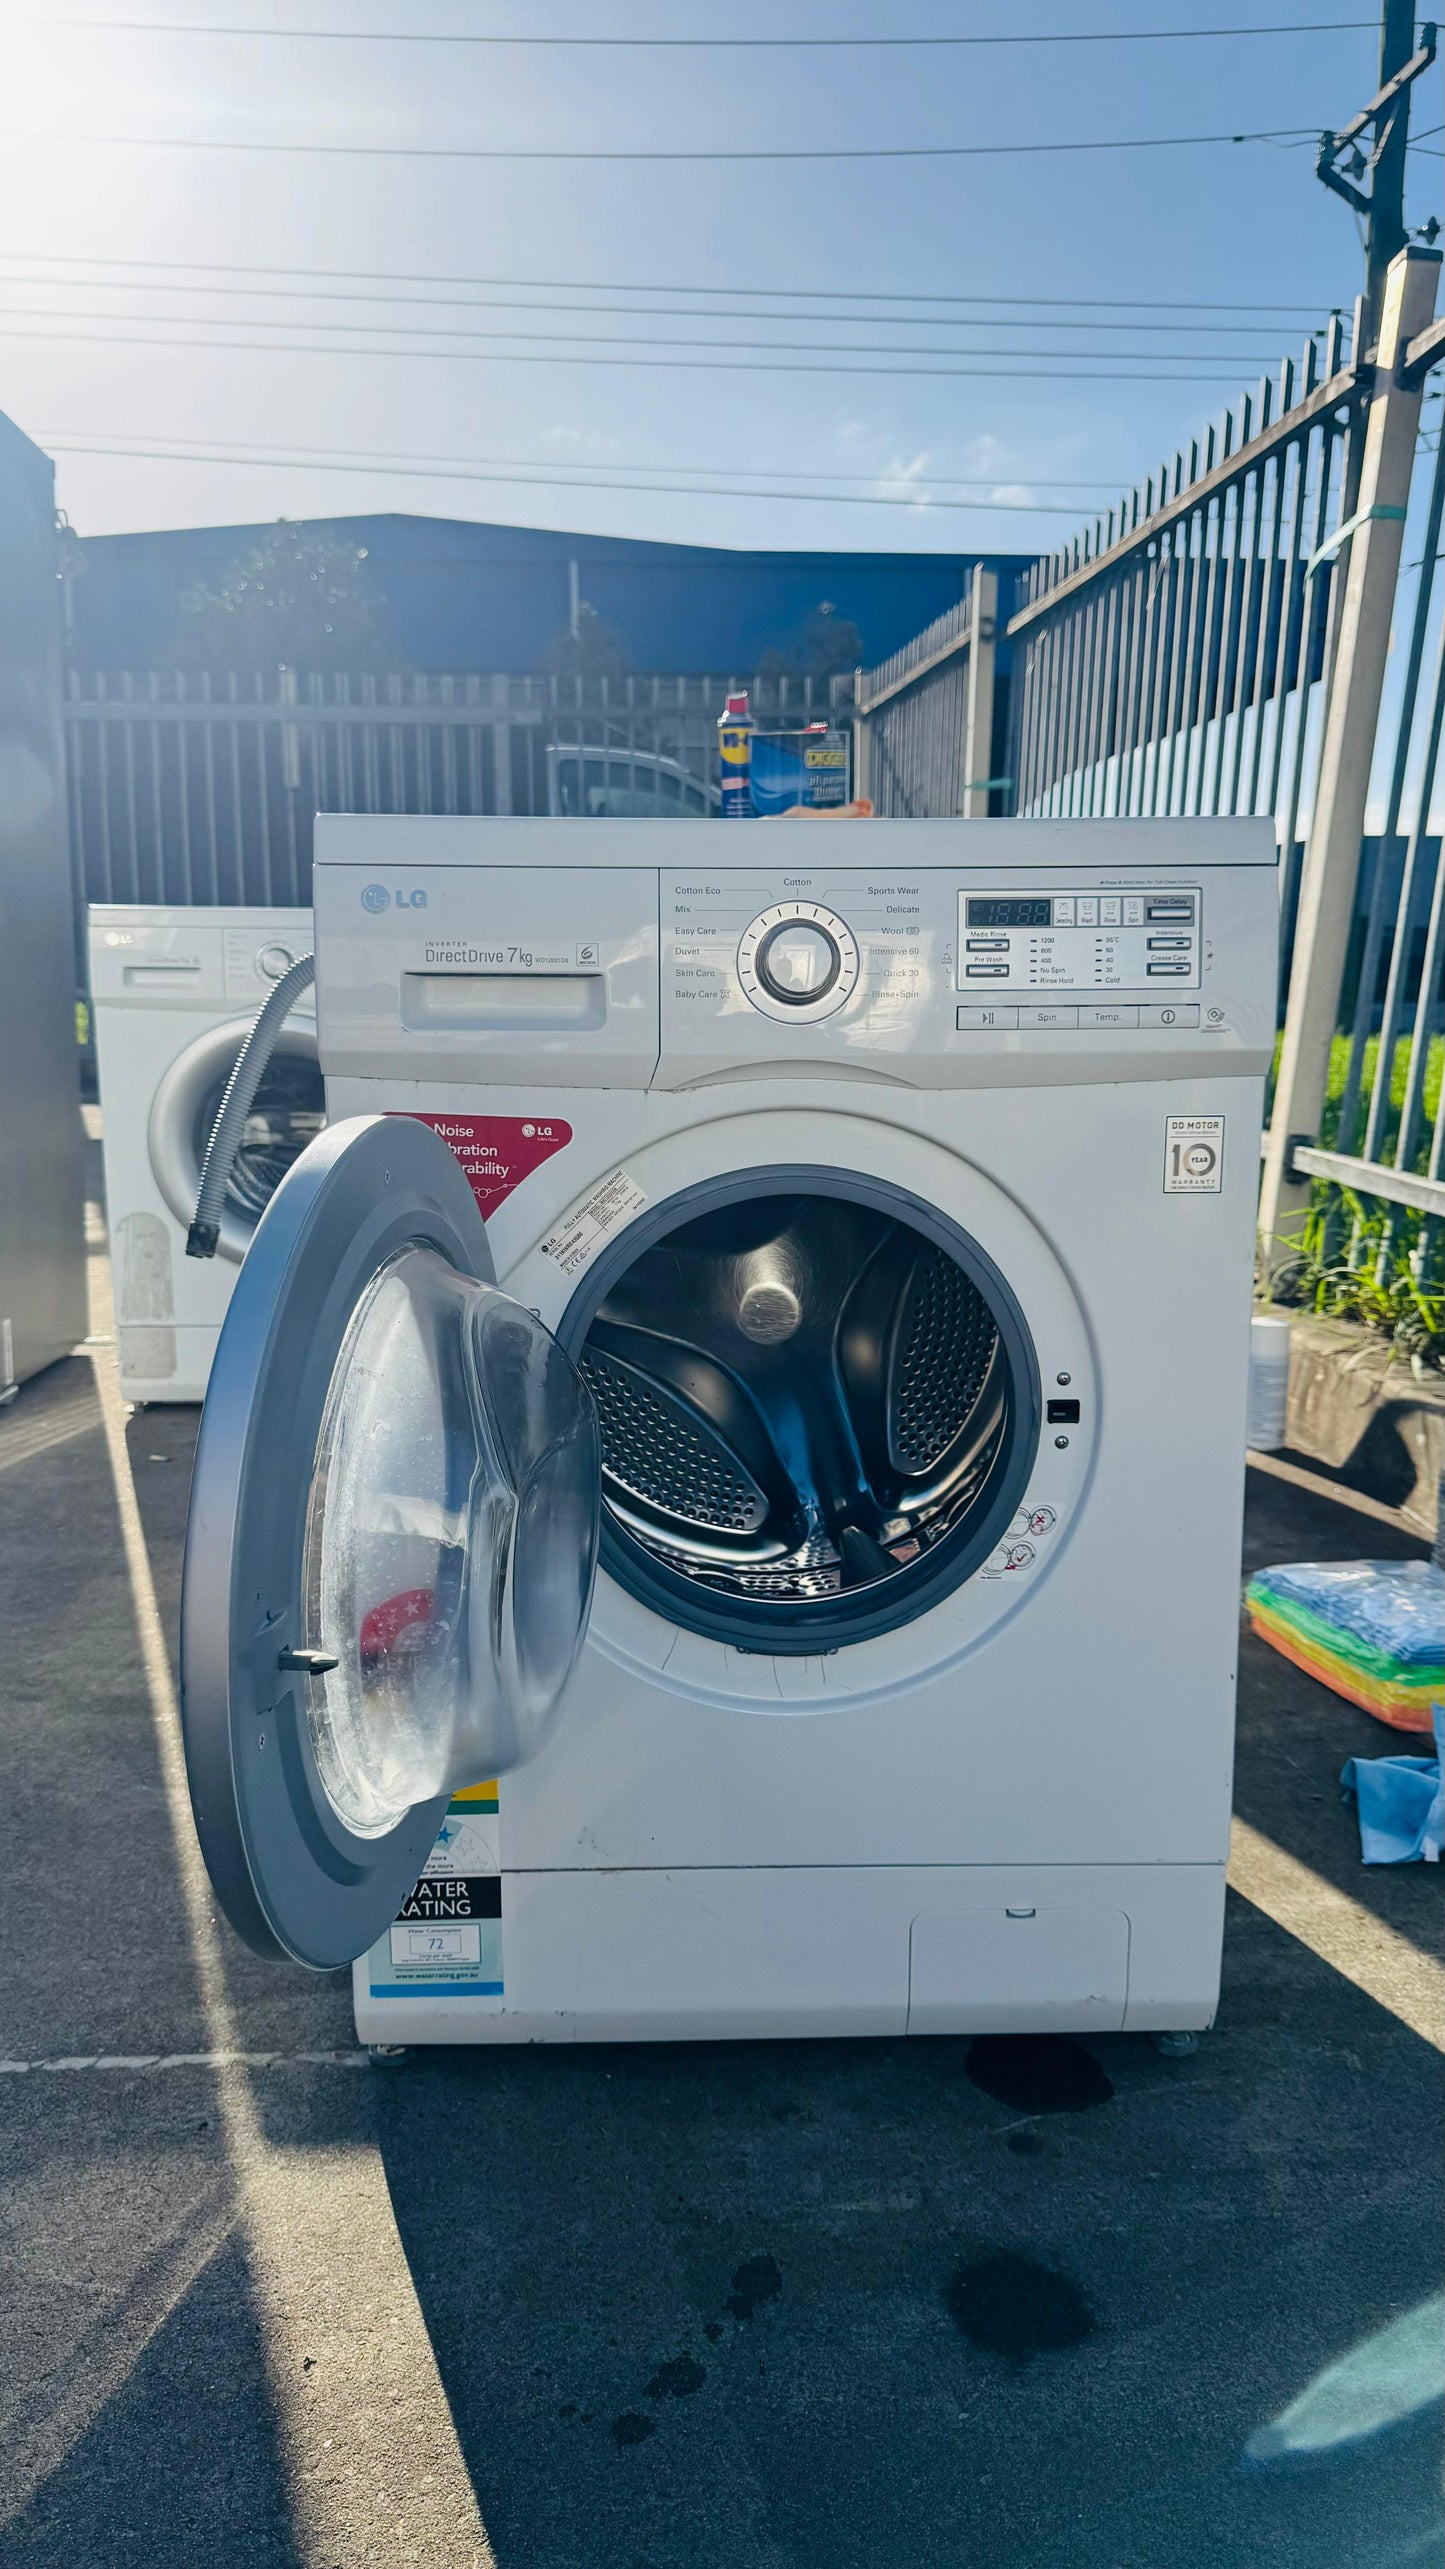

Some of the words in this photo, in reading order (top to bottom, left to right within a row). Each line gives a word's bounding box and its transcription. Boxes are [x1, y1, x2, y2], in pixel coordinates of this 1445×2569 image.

[784, 878, 811, 886] Cotton
[868, 887, 895, 896] Sports
[395, 889, 428, 909] LG
[675, 927, 695, 936] Easy
[697, 927, 716, 935] Care
[675, 990, 696, 1000] Baby
[699, 990, 718, 998] Care
[1038, 1013, 1056, 1022] Spin
[1095, 1013, 1121, 1022] Temp.
[1188, 1121, 1219, 1129] MOTOR
[434, 1123, 474, 1137] Noise
[537, 1127, 552, 1136] LG
[448, 1142, 497, 1156] bration
[1172, 1143, 1216, 1176] 10
[462, 1161, 509, 1178] rability
[564, 1218, 575, 1230] FULLY
[575, 1200, 594, 1220] AUTOMATIC
[593, 1185, 609, 1201] WASHING
[607, 1170, 623, 1187] MACHINE
[548, 1238, 556, 1247] LG
[428, 1939, 444, 1950] 72
